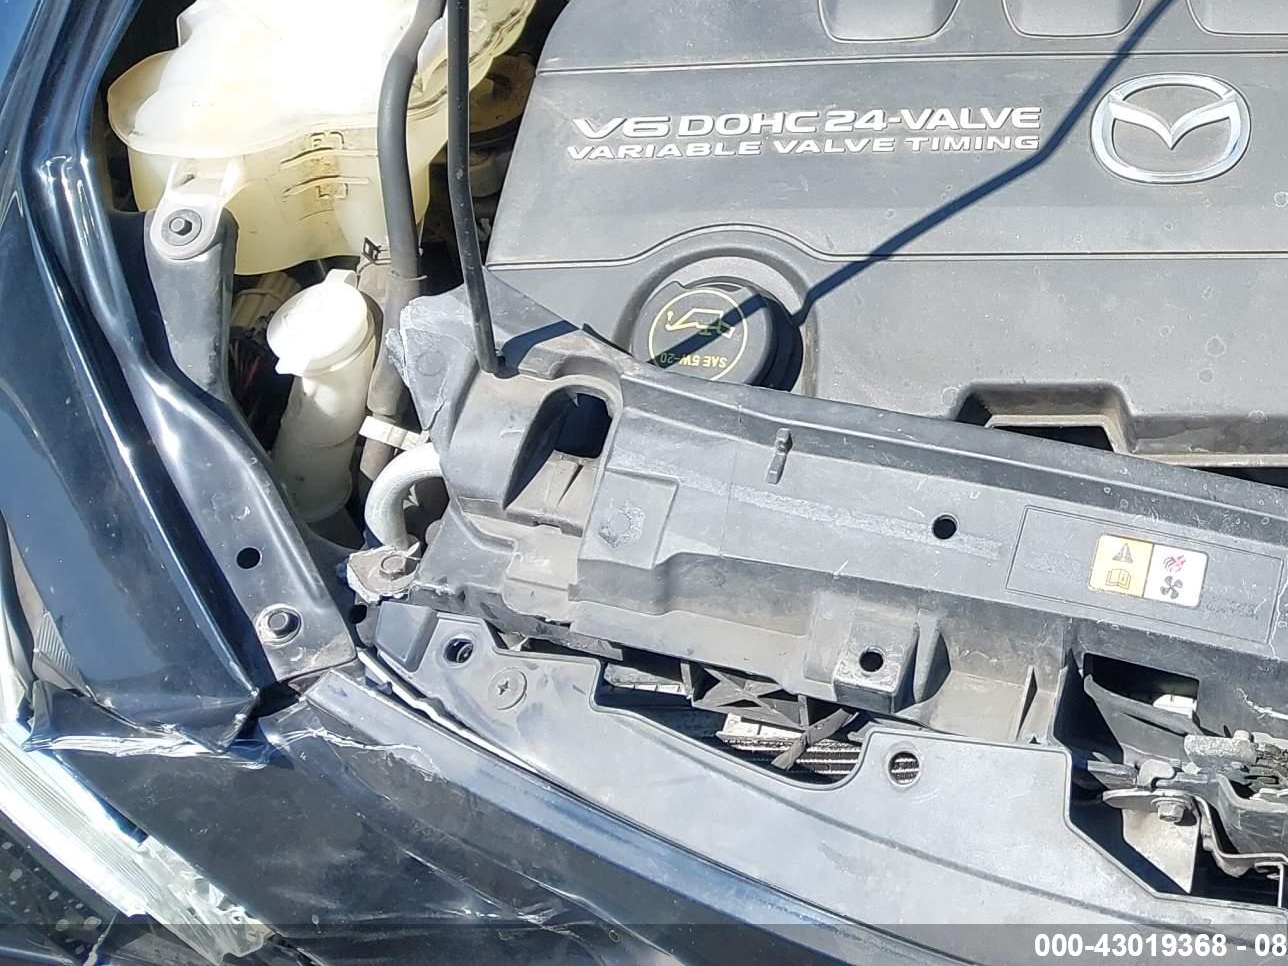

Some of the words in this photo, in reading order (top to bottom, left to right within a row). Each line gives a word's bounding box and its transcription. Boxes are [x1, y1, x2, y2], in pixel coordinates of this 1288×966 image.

[573, 116, 671, 139] V6
[678, 111, 818, 137] DOHC
[824, 106, 1042, 132] 24-VALVE
[566, 140, 763, 160] VARIABLE
[773, 138, 896, 154] VALVE
[904, 135, 1040, 152] TIMING
[660, 352, 701, 367] 5W-20
[703, 355, 728, 368] SAE
